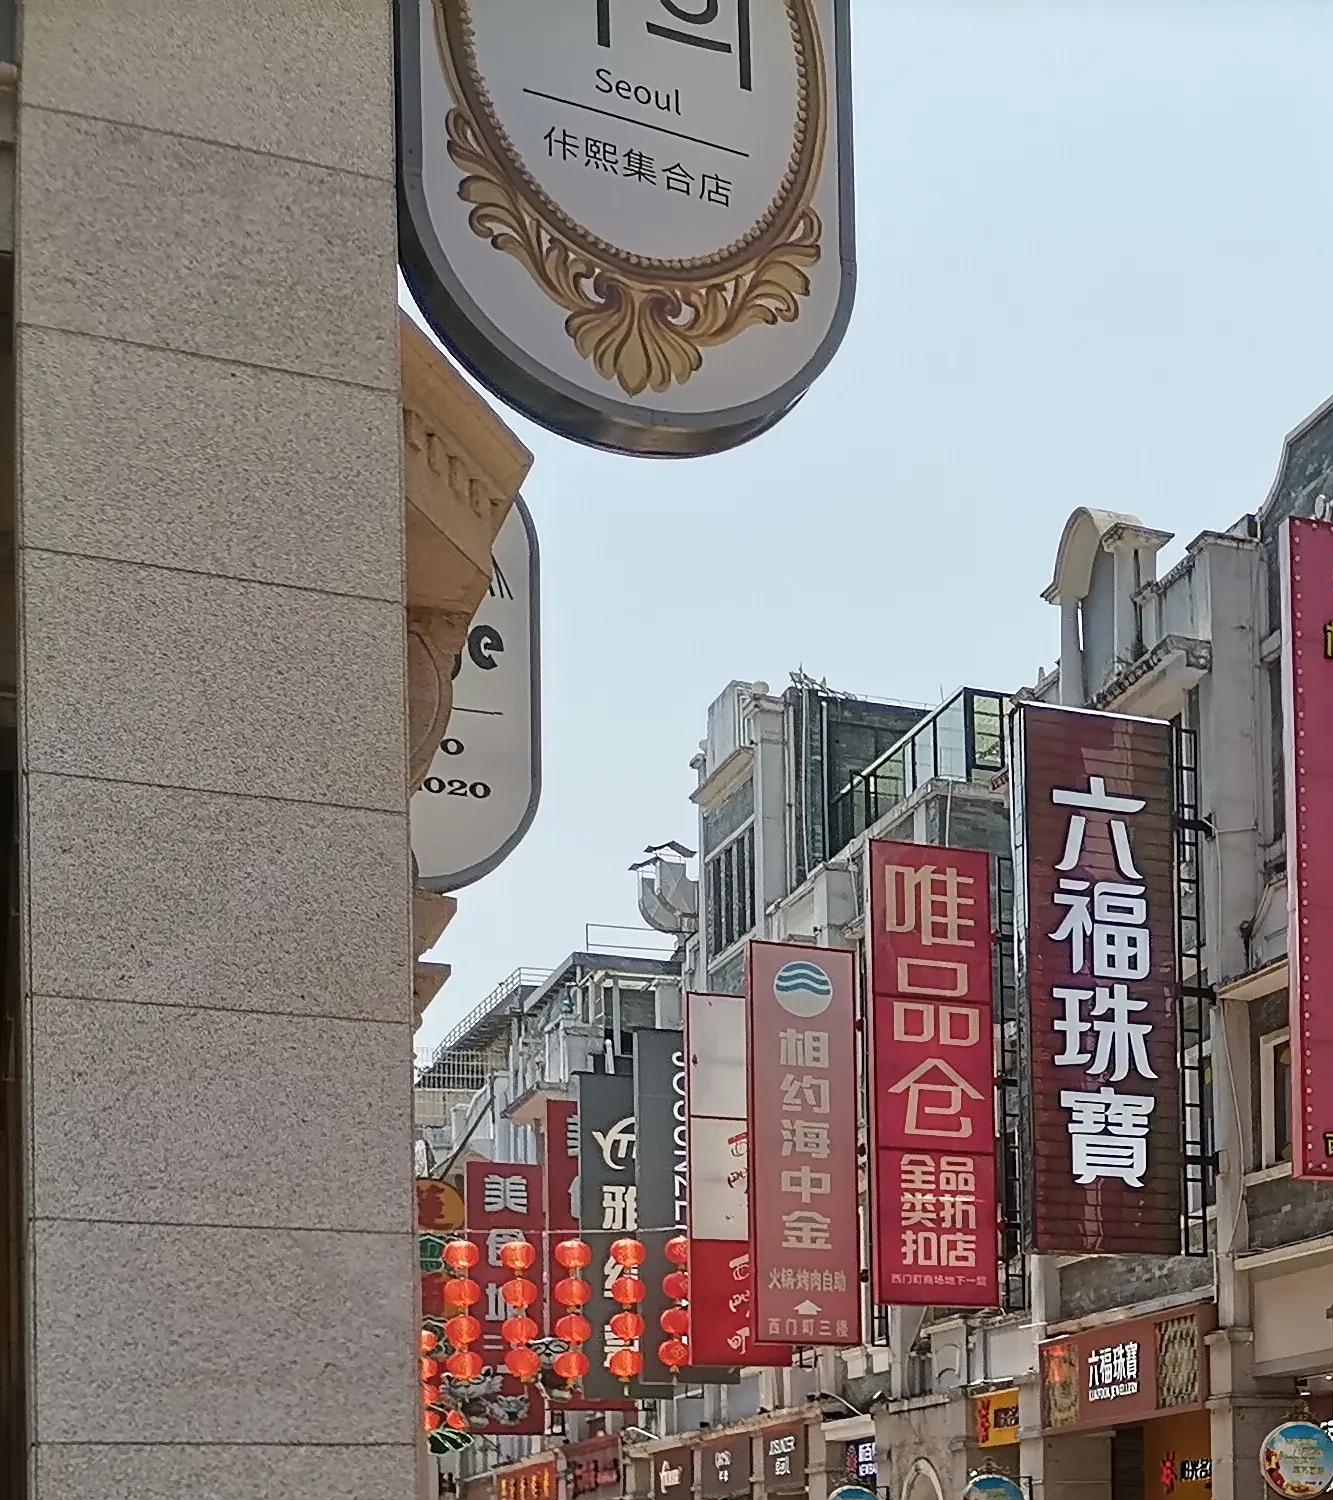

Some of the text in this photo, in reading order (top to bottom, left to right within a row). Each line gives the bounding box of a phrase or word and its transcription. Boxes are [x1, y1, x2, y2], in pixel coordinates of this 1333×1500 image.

[595, 67, 682, 115] Seoul
[543, 125, 733, 207] 佧熙集合店
[420, 775, 491, 799] 020
[885, 864, 984, 1138] 唯品仓
[1048, 778, 1157, 1188] 六福珠寶
[778, 1028, 832, 1250] 相约海中金
[900, 1153, 976, 1191] 全品
[901, 1191, 976, 1229] 类折
[901, 1231, 977, 1268] 扣店
[1087, 1341, 1139, 1388] 六福珠寶
